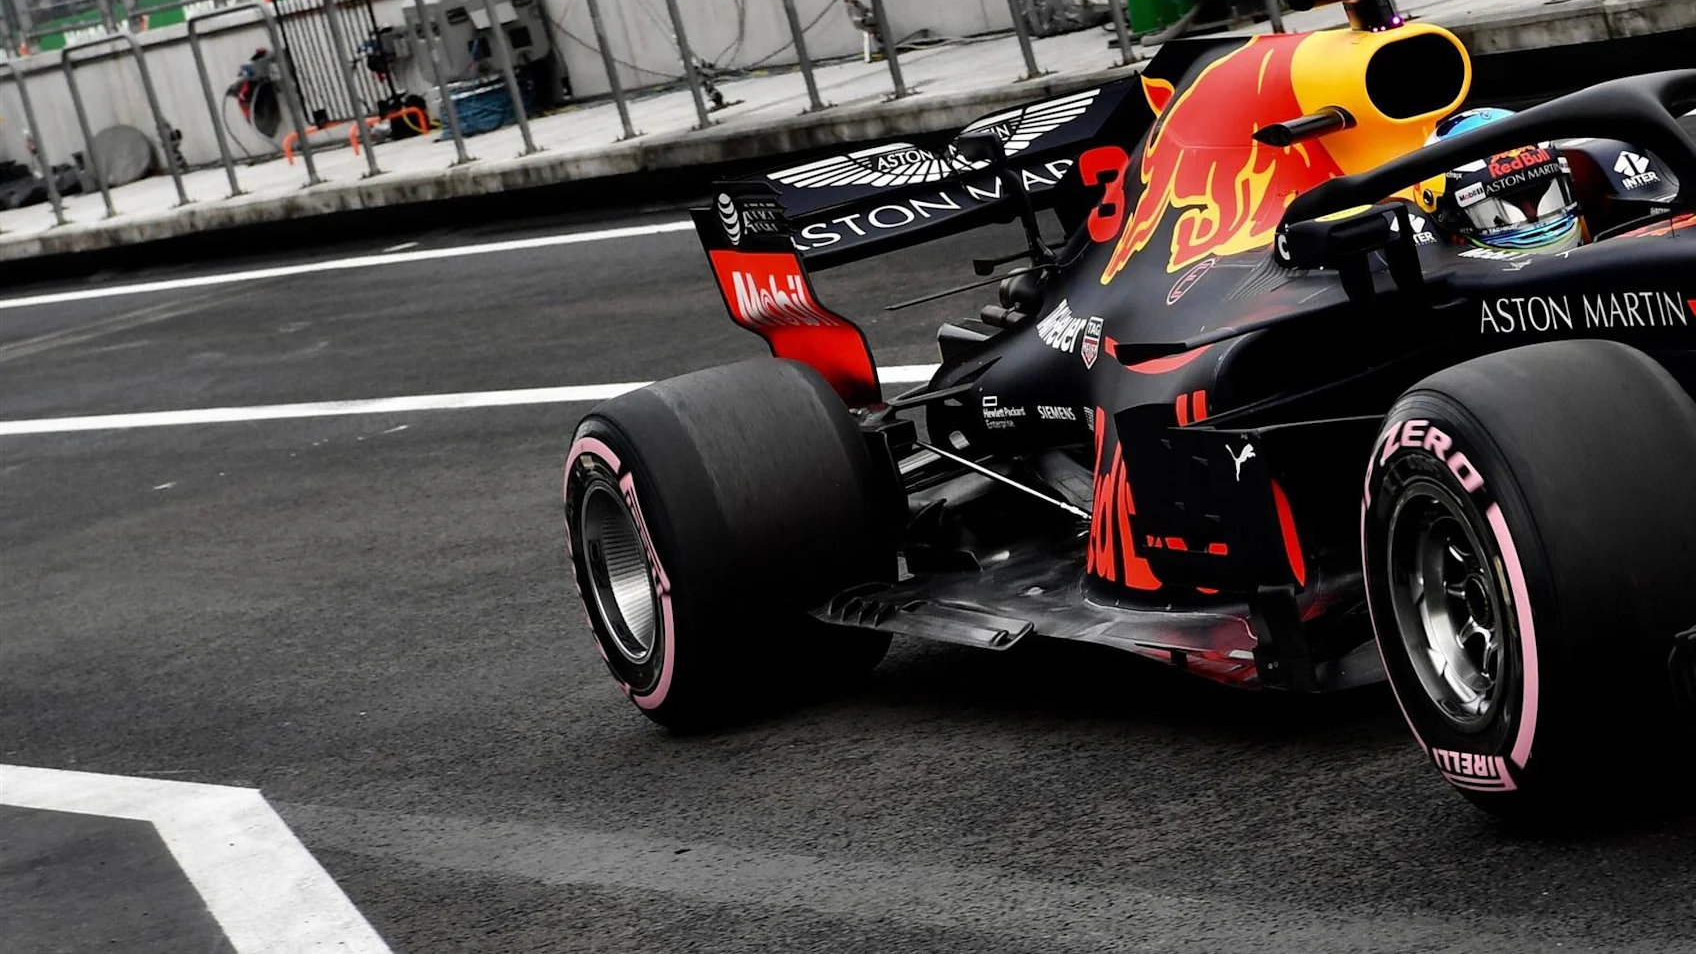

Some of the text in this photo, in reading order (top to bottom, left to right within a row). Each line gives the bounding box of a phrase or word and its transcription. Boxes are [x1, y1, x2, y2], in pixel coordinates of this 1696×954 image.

[877, 148, 935, 172] ASTON
[1488, 148, 1551, 178] Red Bull
[1485, 172, 1526, 195] ASTON
[1622, 171, 1658, 190] INTER
[1079, 146, 1130, 243] 3
[1481, 291, 1687, 333] ASTON MARTIN
[983, 406, 1026, 419] Hewlett Packard
[1037, 405, 1077, 420] SIEMENS
[1379, 419, 1485, 494] ZERO
[1431, 747, 1518, 792] PIRELLI
